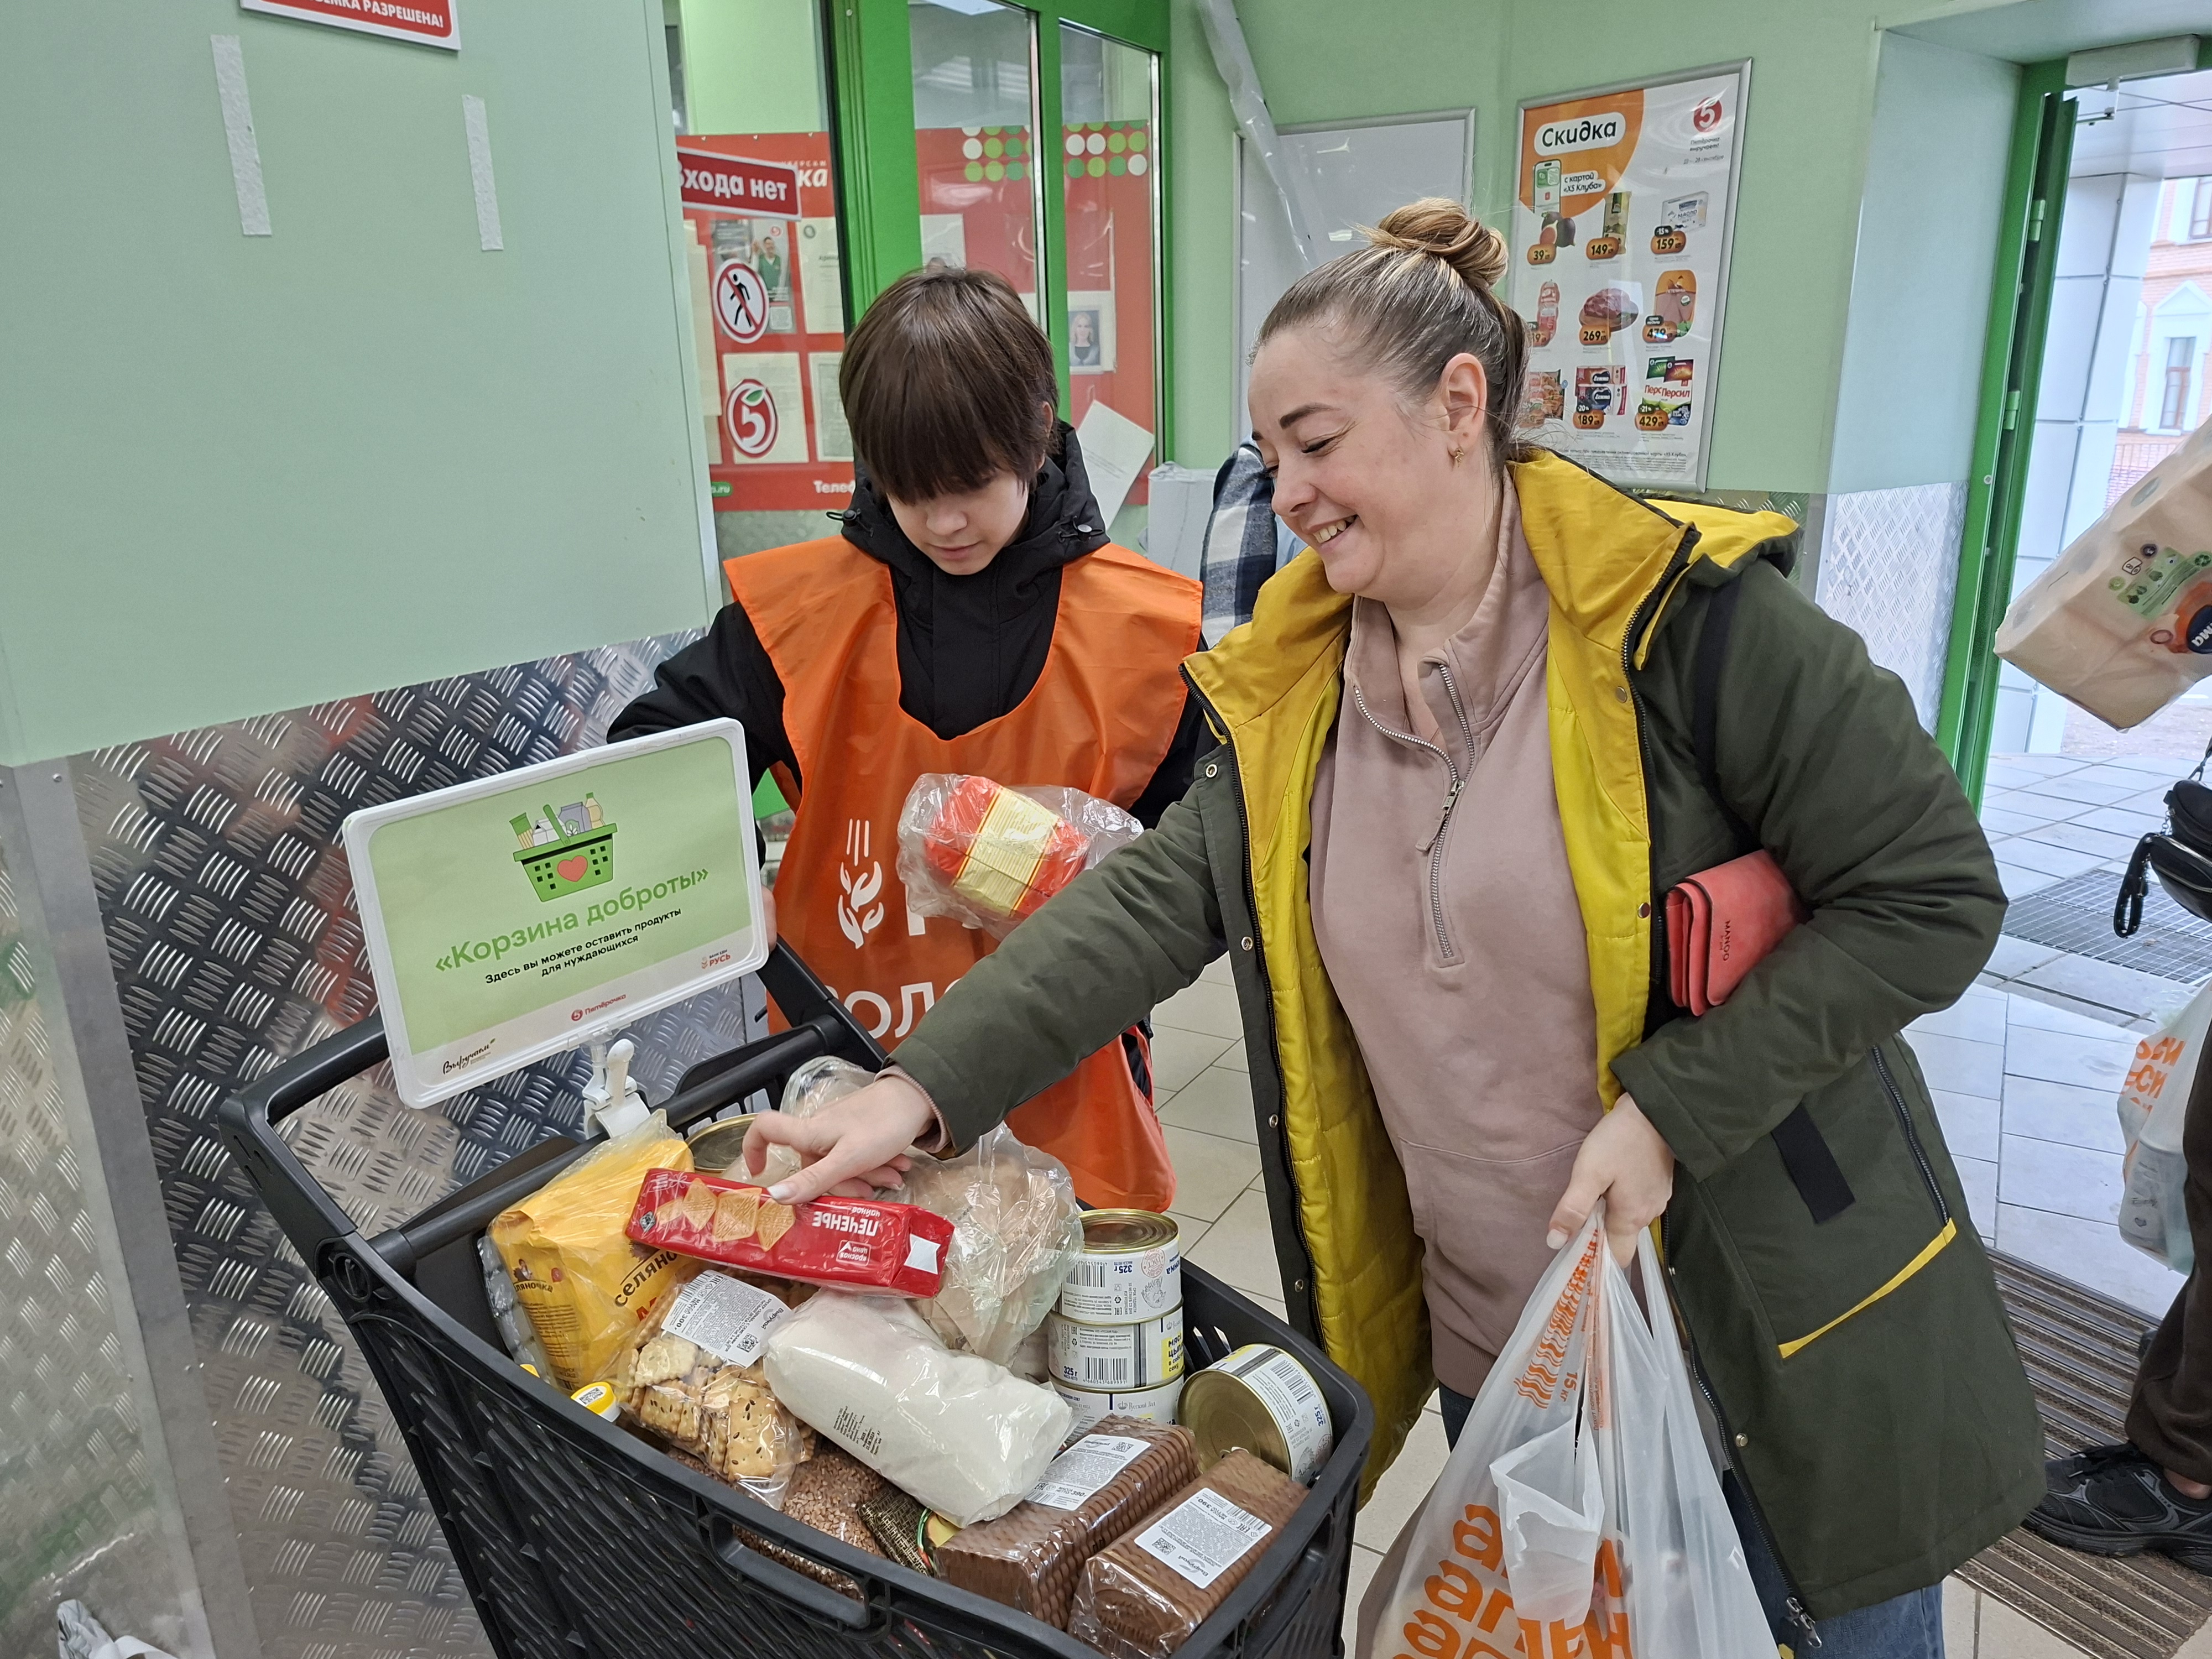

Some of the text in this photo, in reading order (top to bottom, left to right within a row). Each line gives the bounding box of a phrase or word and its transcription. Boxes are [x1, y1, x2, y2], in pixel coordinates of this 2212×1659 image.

[363, 0, 444, 28] РАЗРЕШЕНА!
[1542, 121, 1616, 147] Скидка
[797, 168, 828, 187] ка
[1569, 173, 1594, 183] картой
[750, 179, 787, 201] нет
[1592, 244, 1608, 255] 149
[1656, 238, 1674, 250] 159
[1533, 250, 1545, 260] 39
[1583, 331, 1601, 341] 269
[1662, 388, 1691, 399] Персил
[1578, 415, 1594, 425] 189
[1639, 416, 1658, 426] 429
[435, 868, 709, 972] «Корзина доброты»
[485, 909, 682, 984] Здесь вы можете оставить продукты
[541, 935, 639, 977] для нуждающихся
[709, 954, 731, 967] РУСЬ
[585, 994, 627, 1015] Пятёрочка
[852, 1207, 881, 1217] чайное
[811, 1211, 879, 1237] ПЕЧЕНЬЕ
[852, 1246, 868, 1254] цена
[840, 1252, 868, 1262] красная
[1119, 1265, 1133, 1274] 325
[513, 1282, 554, 1293] ляночка
[675, 1313, 687, 1328] 300
[761, 1307, 784, 1329] Выручай
[1168, 1332, 1182, 1348] МЯС
[1168, 1344, 1183, 1358] ЦЫП
[1064, 1365, 1074, 1375] 325
[1559, 1371, 1578, 1402] 15 кг
[1315, 1410, 1324, 1427] 325
[1198, 1498, 1211, 1509] 390
[1178, 1555, 1209, 1577] Выручай
